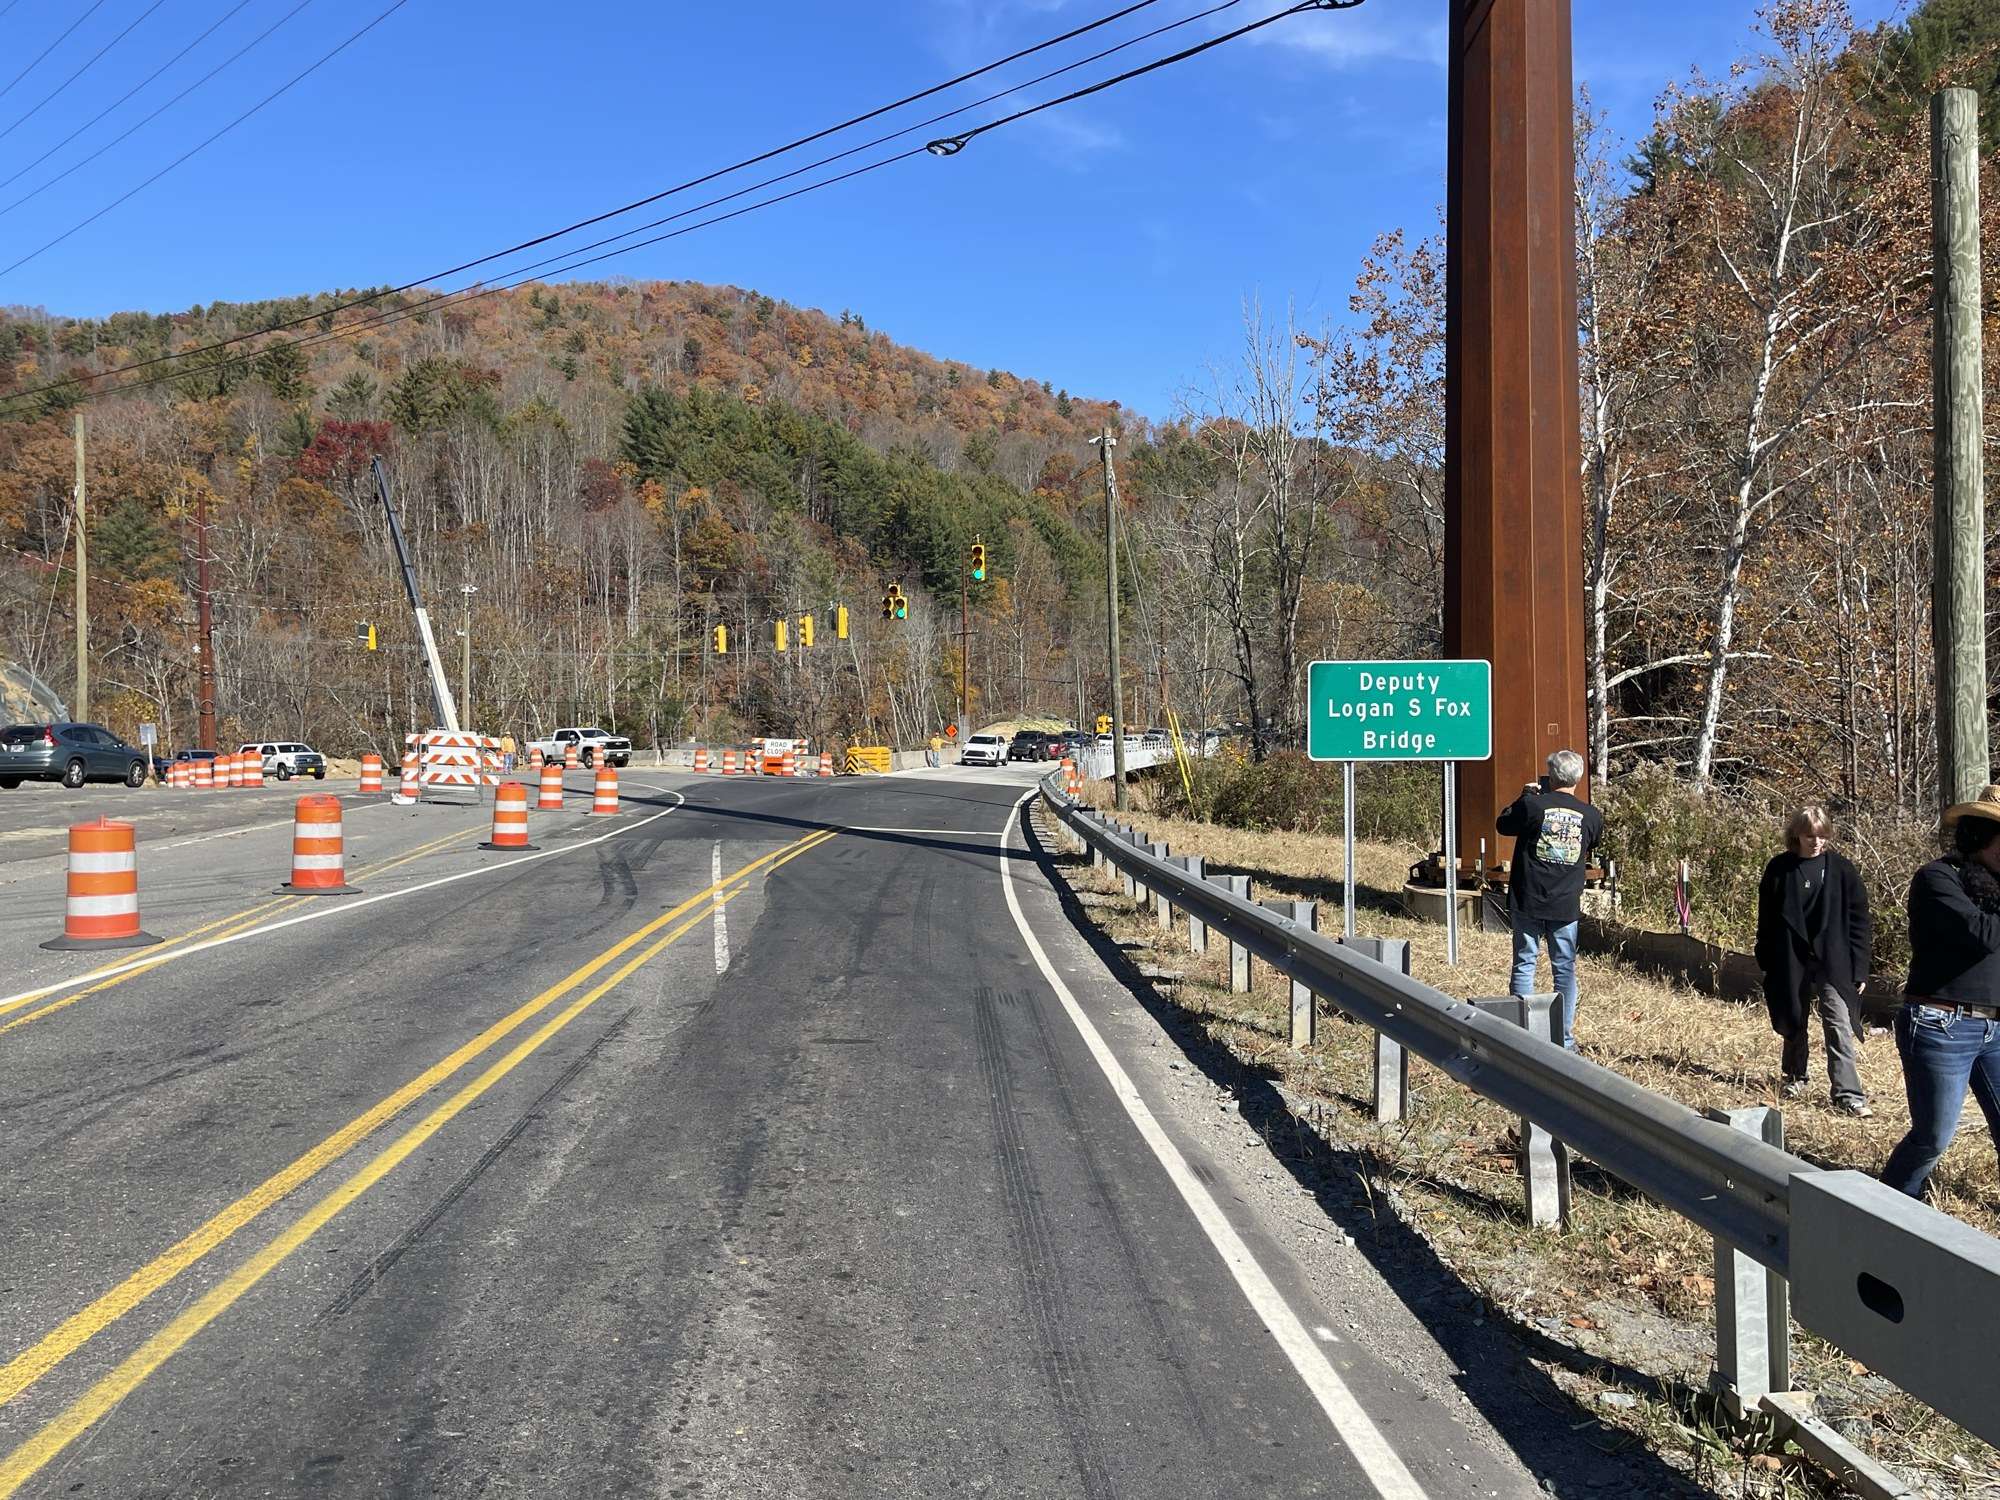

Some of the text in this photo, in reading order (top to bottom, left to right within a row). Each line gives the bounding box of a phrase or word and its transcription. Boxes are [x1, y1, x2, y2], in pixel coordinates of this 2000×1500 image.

[1361, 673, 1439, 695] Deputy
[1329, 698, 1470, 721] Logan S Fox
[1364, 731, 1435, 753] Bridge
